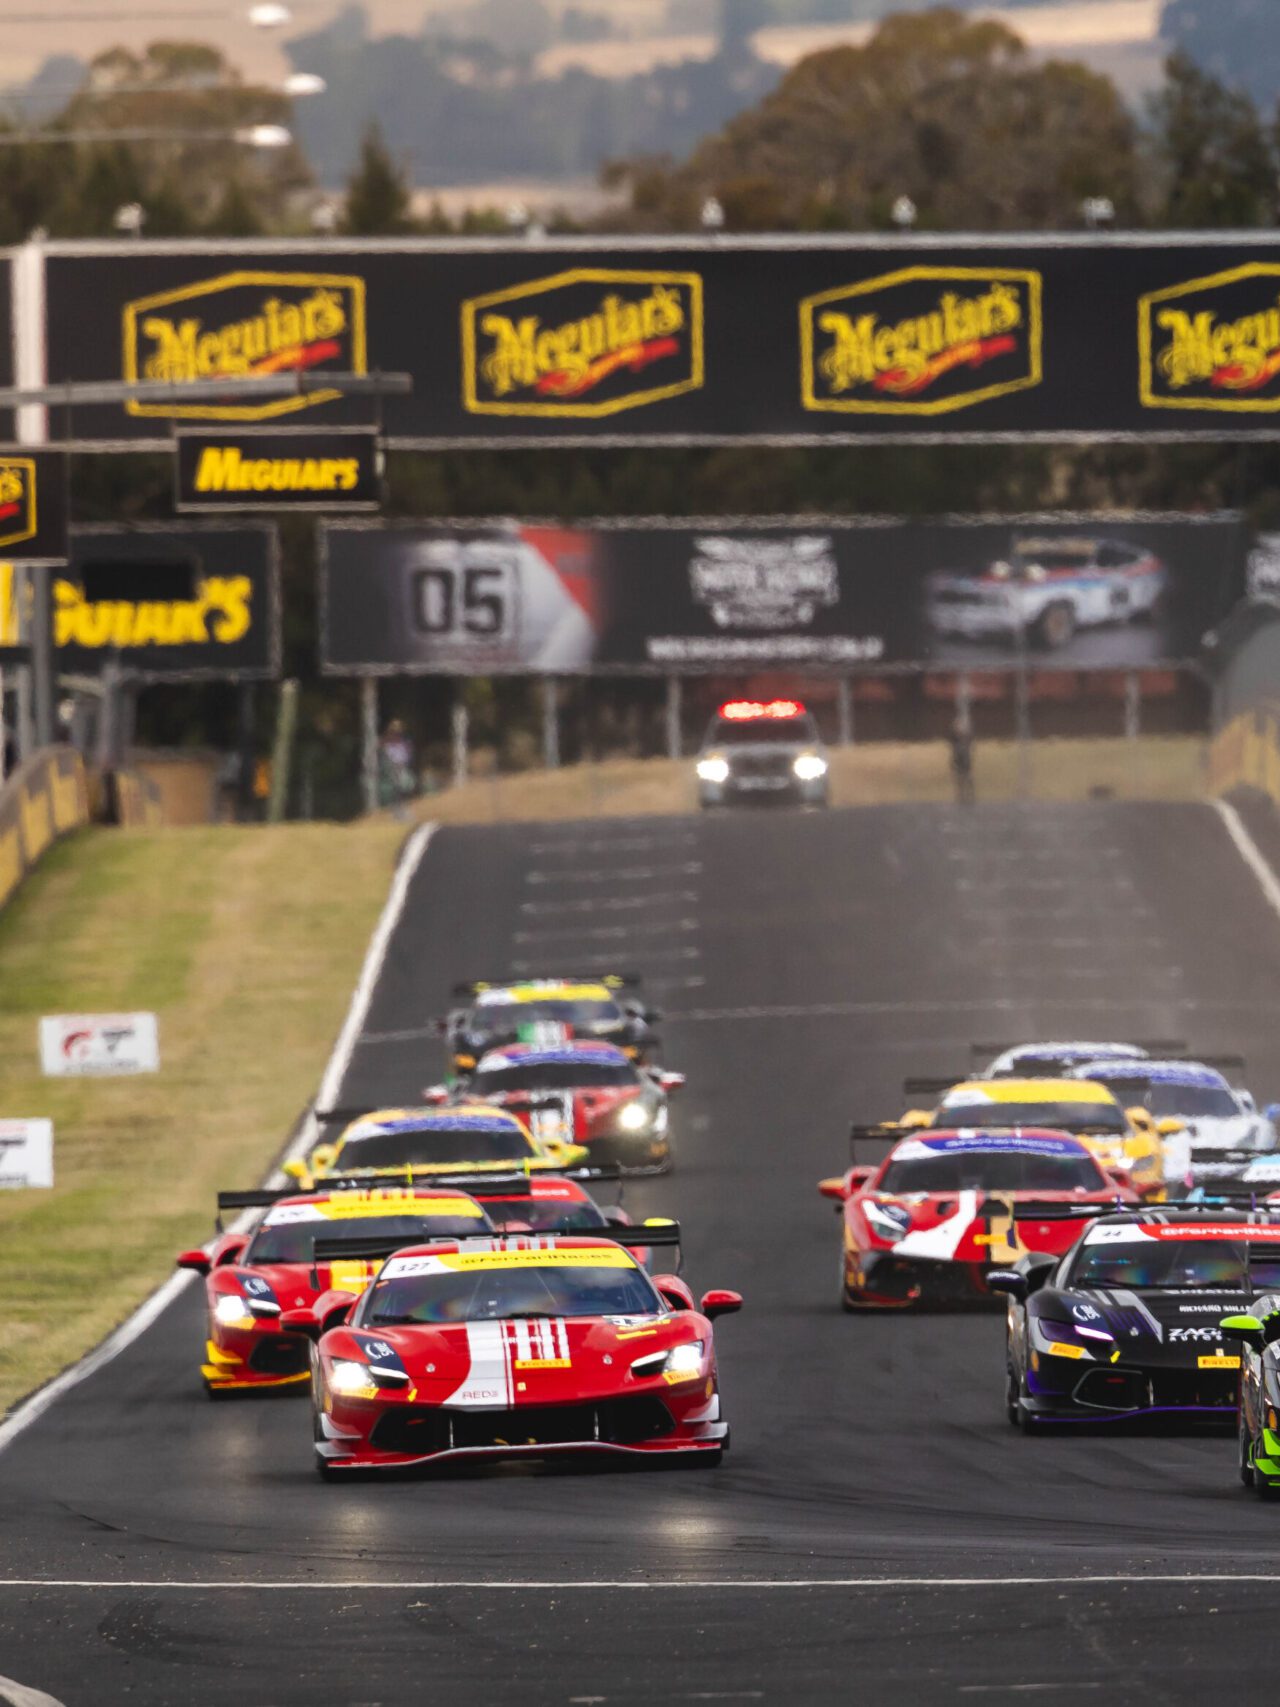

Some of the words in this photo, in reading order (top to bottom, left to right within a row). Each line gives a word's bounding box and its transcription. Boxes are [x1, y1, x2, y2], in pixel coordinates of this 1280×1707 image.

[481, 284, 685, 394] Meguiar's
[819, 281, 1021, 392] Meguiar's
[412, 568, 503, 633] 05
